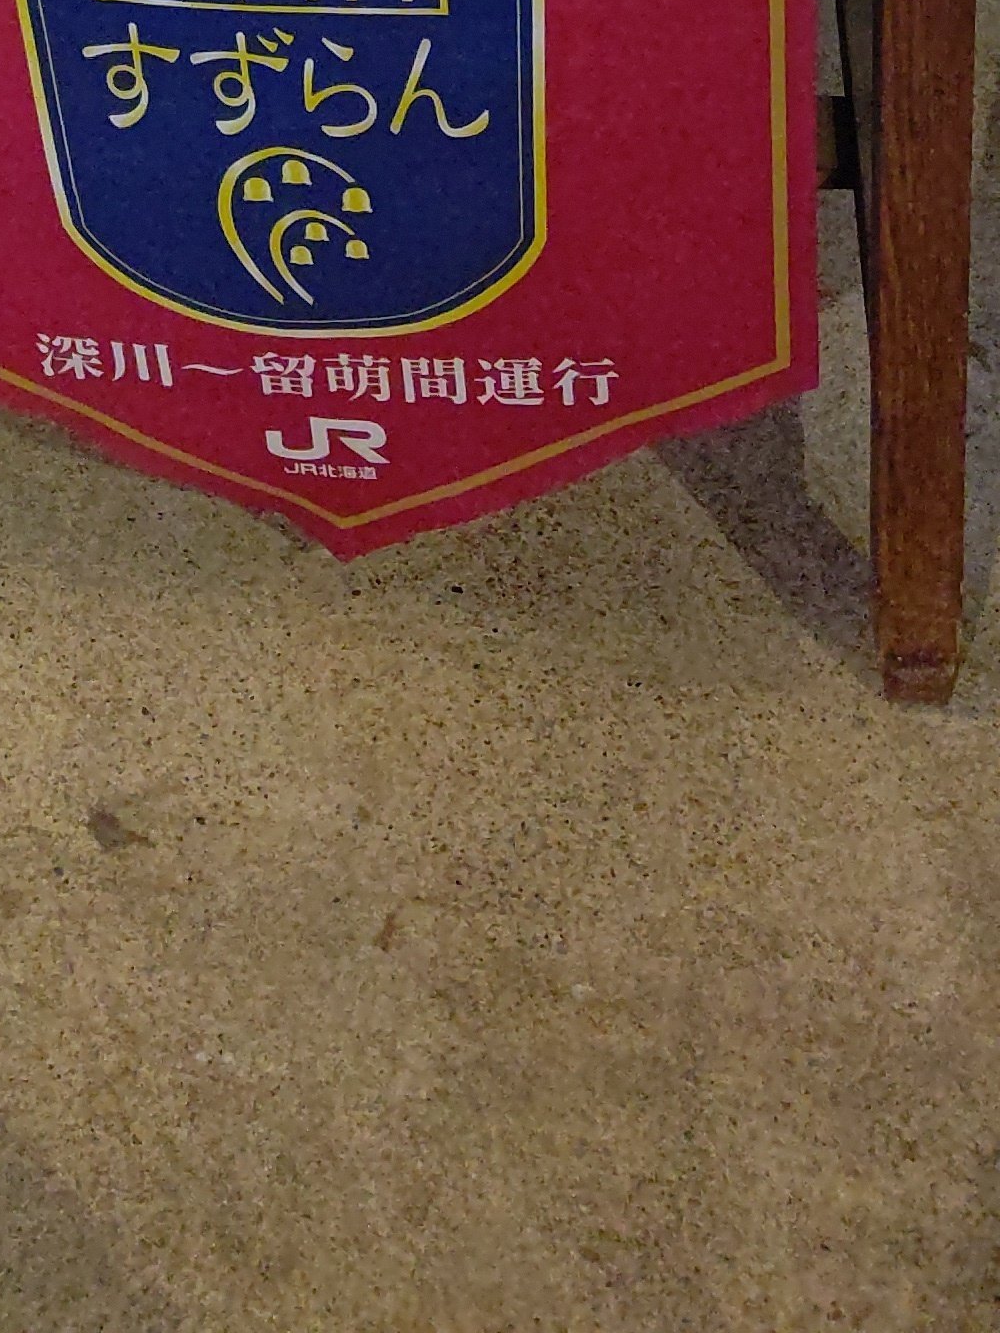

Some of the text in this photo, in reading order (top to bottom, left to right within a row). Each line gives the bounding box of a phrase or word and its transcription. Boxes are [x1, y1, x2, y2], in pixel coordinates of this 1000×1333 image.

[81, 21, 490, 138] すずらん
[265, 416, 391, 464] JR
[284, 462, 378, 480] JR北海道
